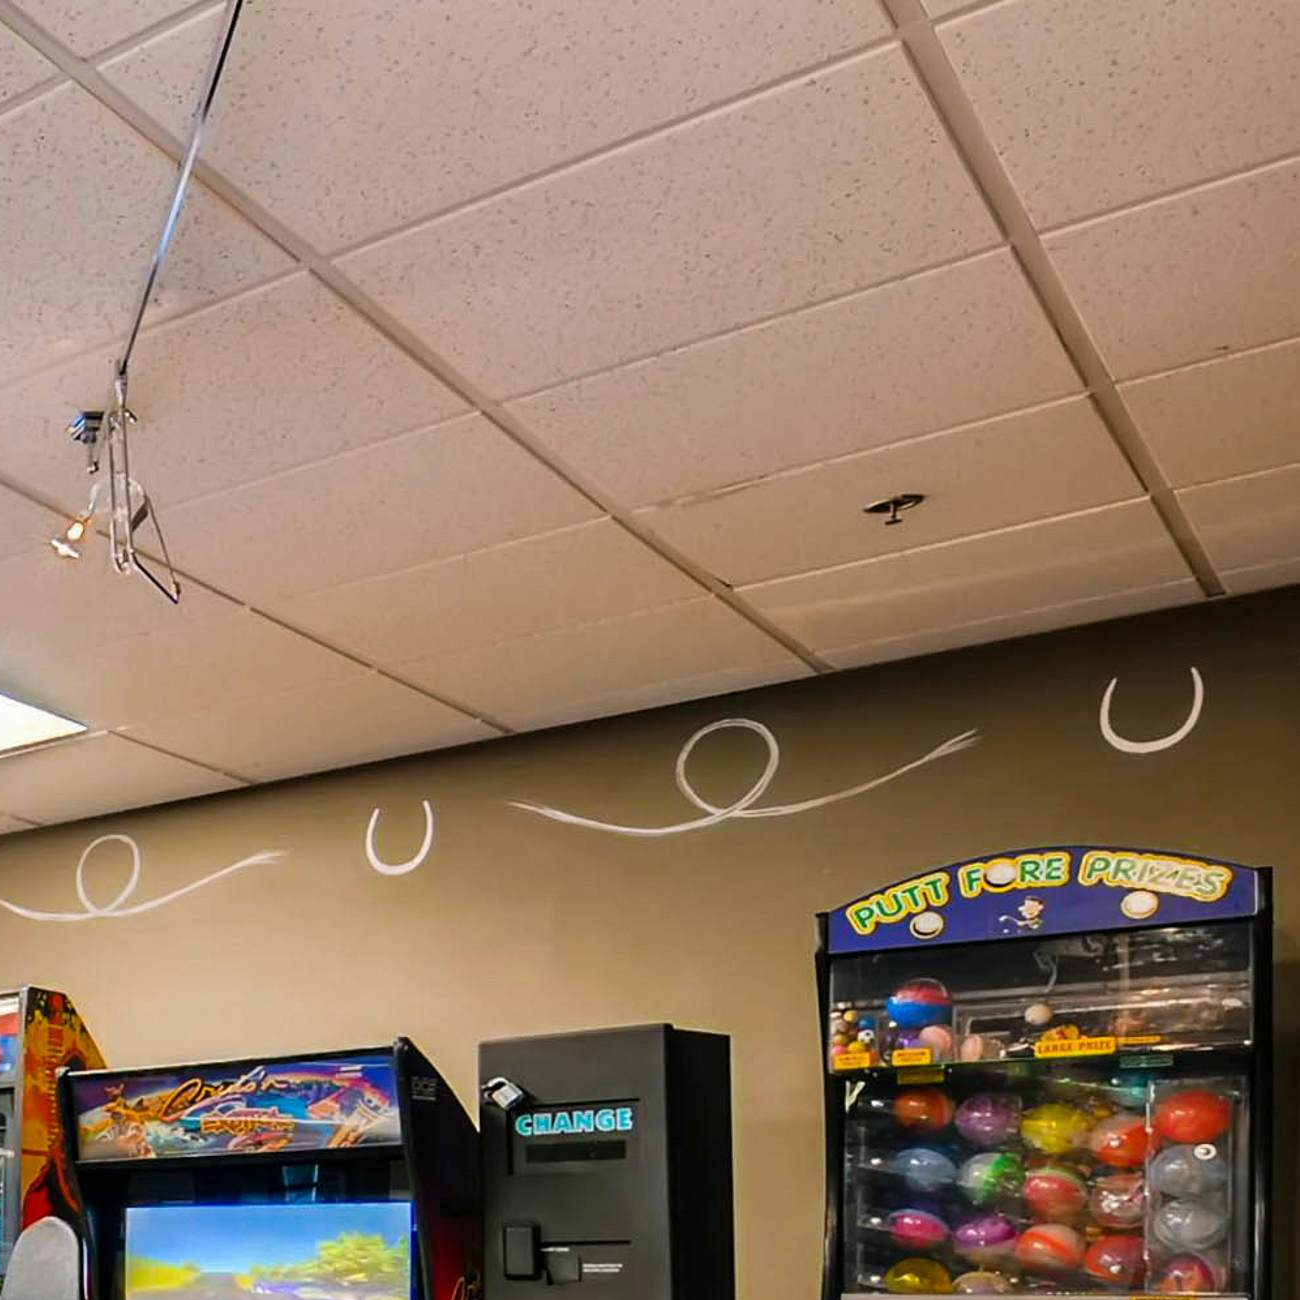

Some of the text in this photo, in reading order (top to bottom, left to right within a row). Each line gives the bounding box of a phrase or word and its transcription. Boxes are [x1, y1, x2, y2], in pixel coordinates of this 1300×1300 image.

[854, 876, 948, 929] PUTT
[1084, 854, 1226, 897] PRIZES
[515, 1107, 633, 1136] CHANGE
